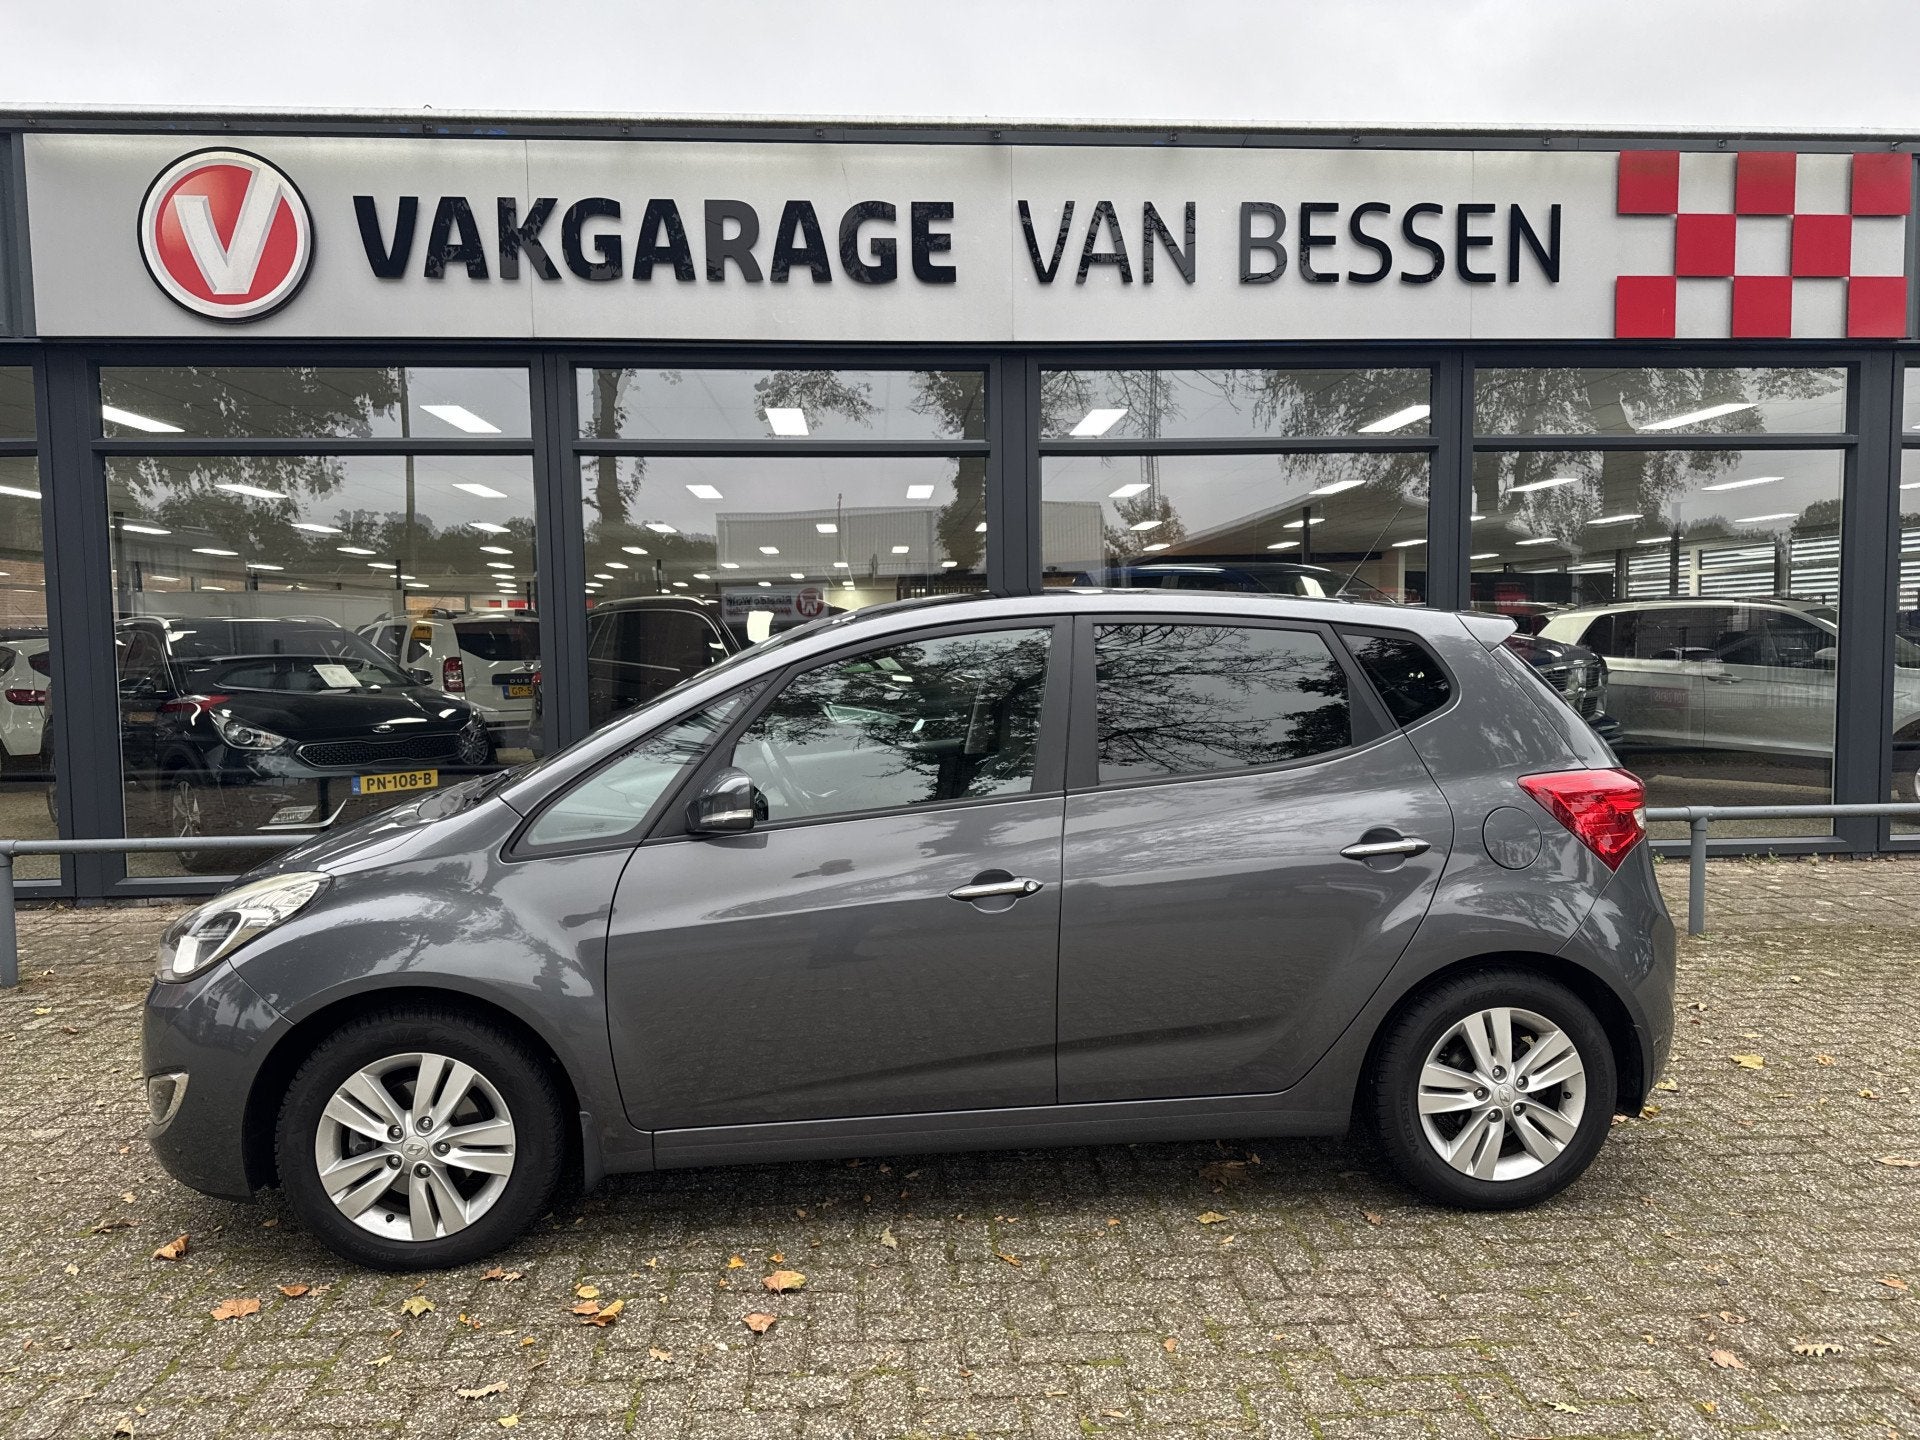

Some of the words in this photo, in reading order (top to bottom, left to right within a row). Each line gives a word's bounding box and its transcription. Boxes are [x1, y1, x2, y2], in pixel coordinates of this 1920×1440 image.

[173, 161, 284, 295] V
[353, 195, 957, 285] VAKGARAGE
[1018, 199, 1197, 285] VAN
[1239, 201, 1562, 285] BESSEN
[366, 772, 432, 791] PN-108-B
